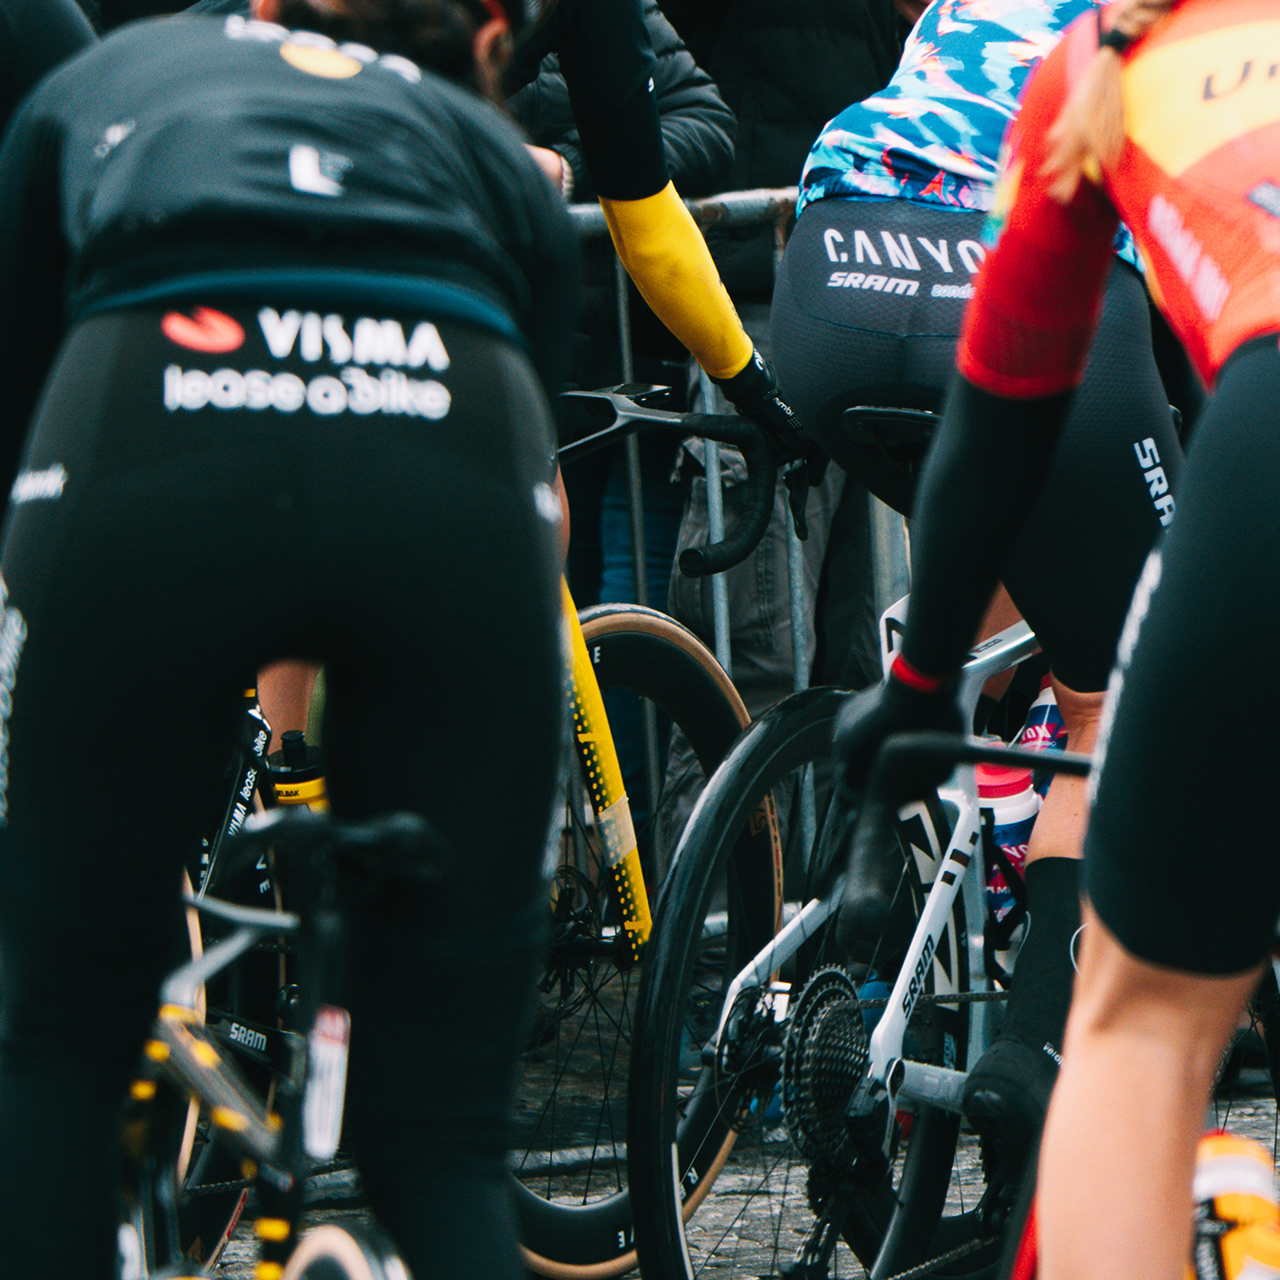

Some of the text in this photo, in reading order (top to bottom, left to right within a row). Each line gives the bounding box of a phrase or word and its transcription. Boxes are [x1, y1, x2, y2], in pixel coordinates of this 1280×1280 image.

[823, 228, 986, 274] CANYO
[827, 272, 920, 296] SRAM
[257, 306, 450, 372] VISMA
[1133, 437, 1176, 528] SRA
[902, 932, 935, 1020] SRAM
[229, 1022, 267, 1051] SRAM
